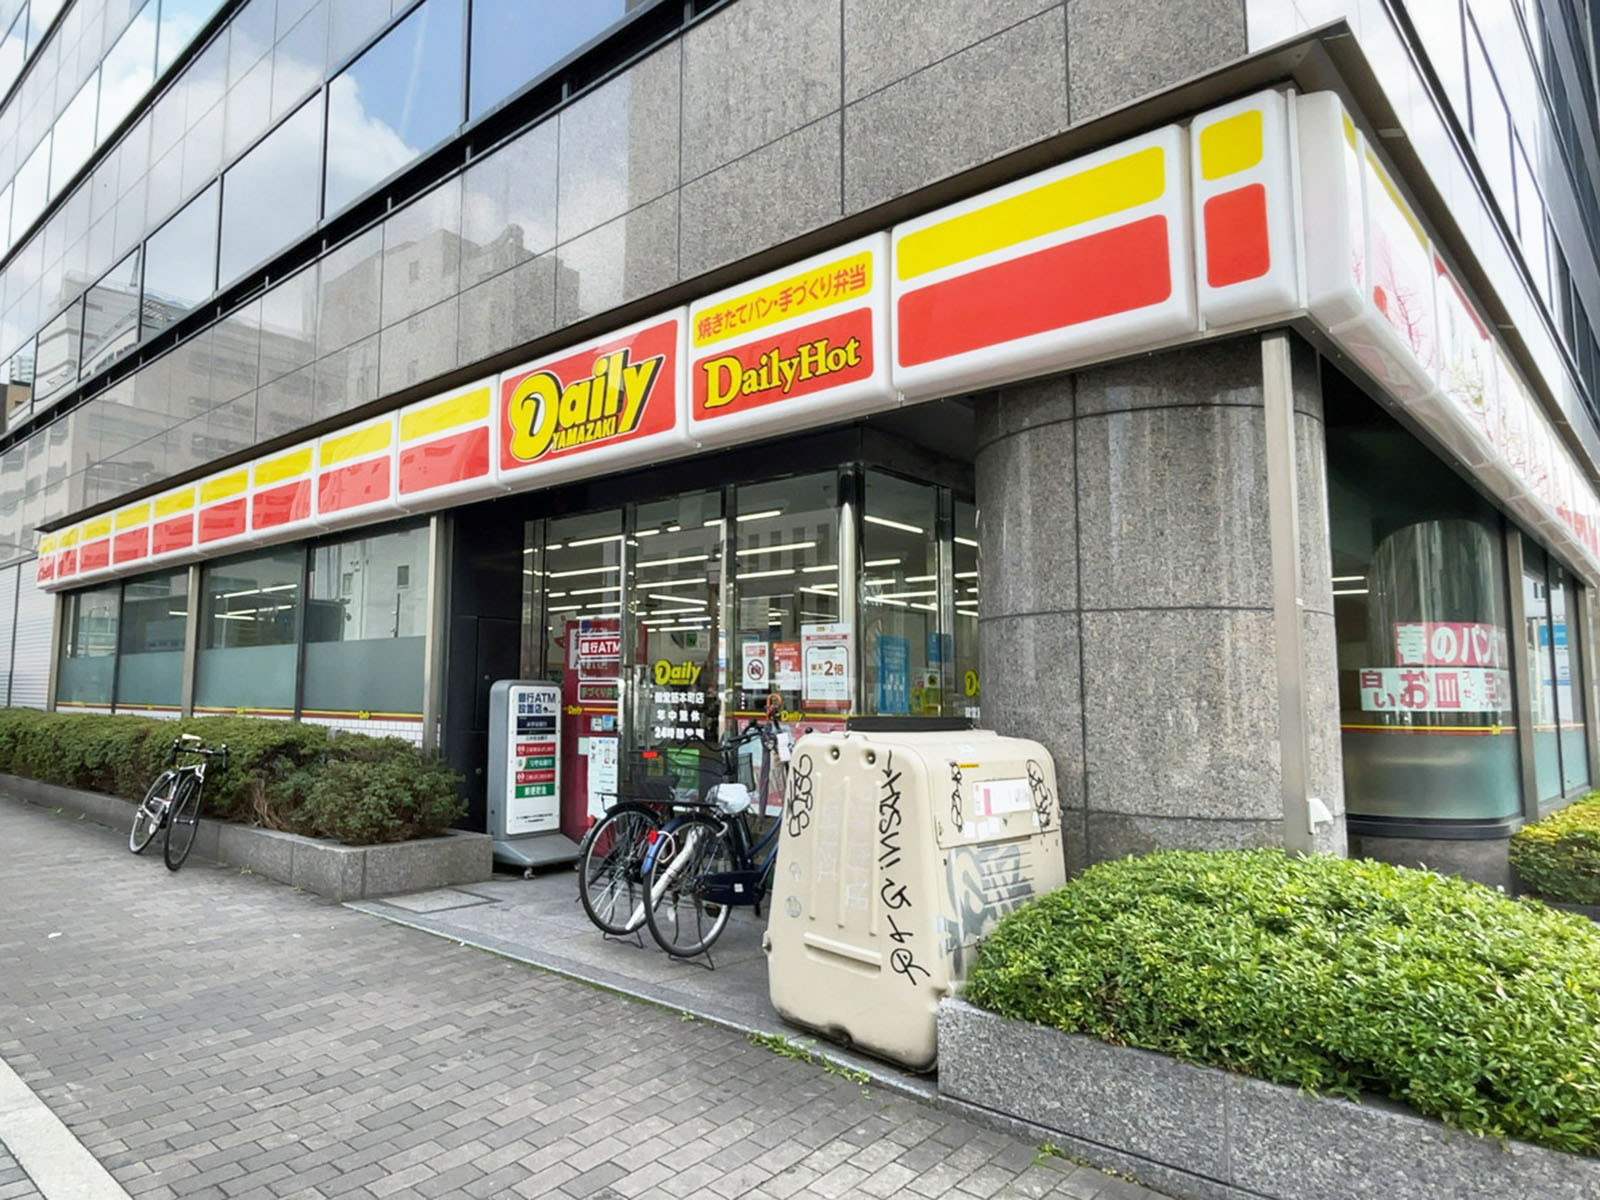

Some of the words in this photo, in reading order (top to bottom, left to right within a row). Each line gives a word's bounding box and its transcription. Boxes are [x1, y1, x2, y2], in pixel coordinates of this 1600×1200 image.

[697, 263, 866, 340] 焼きたてパン・手づくり弁当
[509, 348, 664, 461] Daily
[552, 415, 617, 451] YAMAZAKI
[655, 660, 702, 686] Daily
